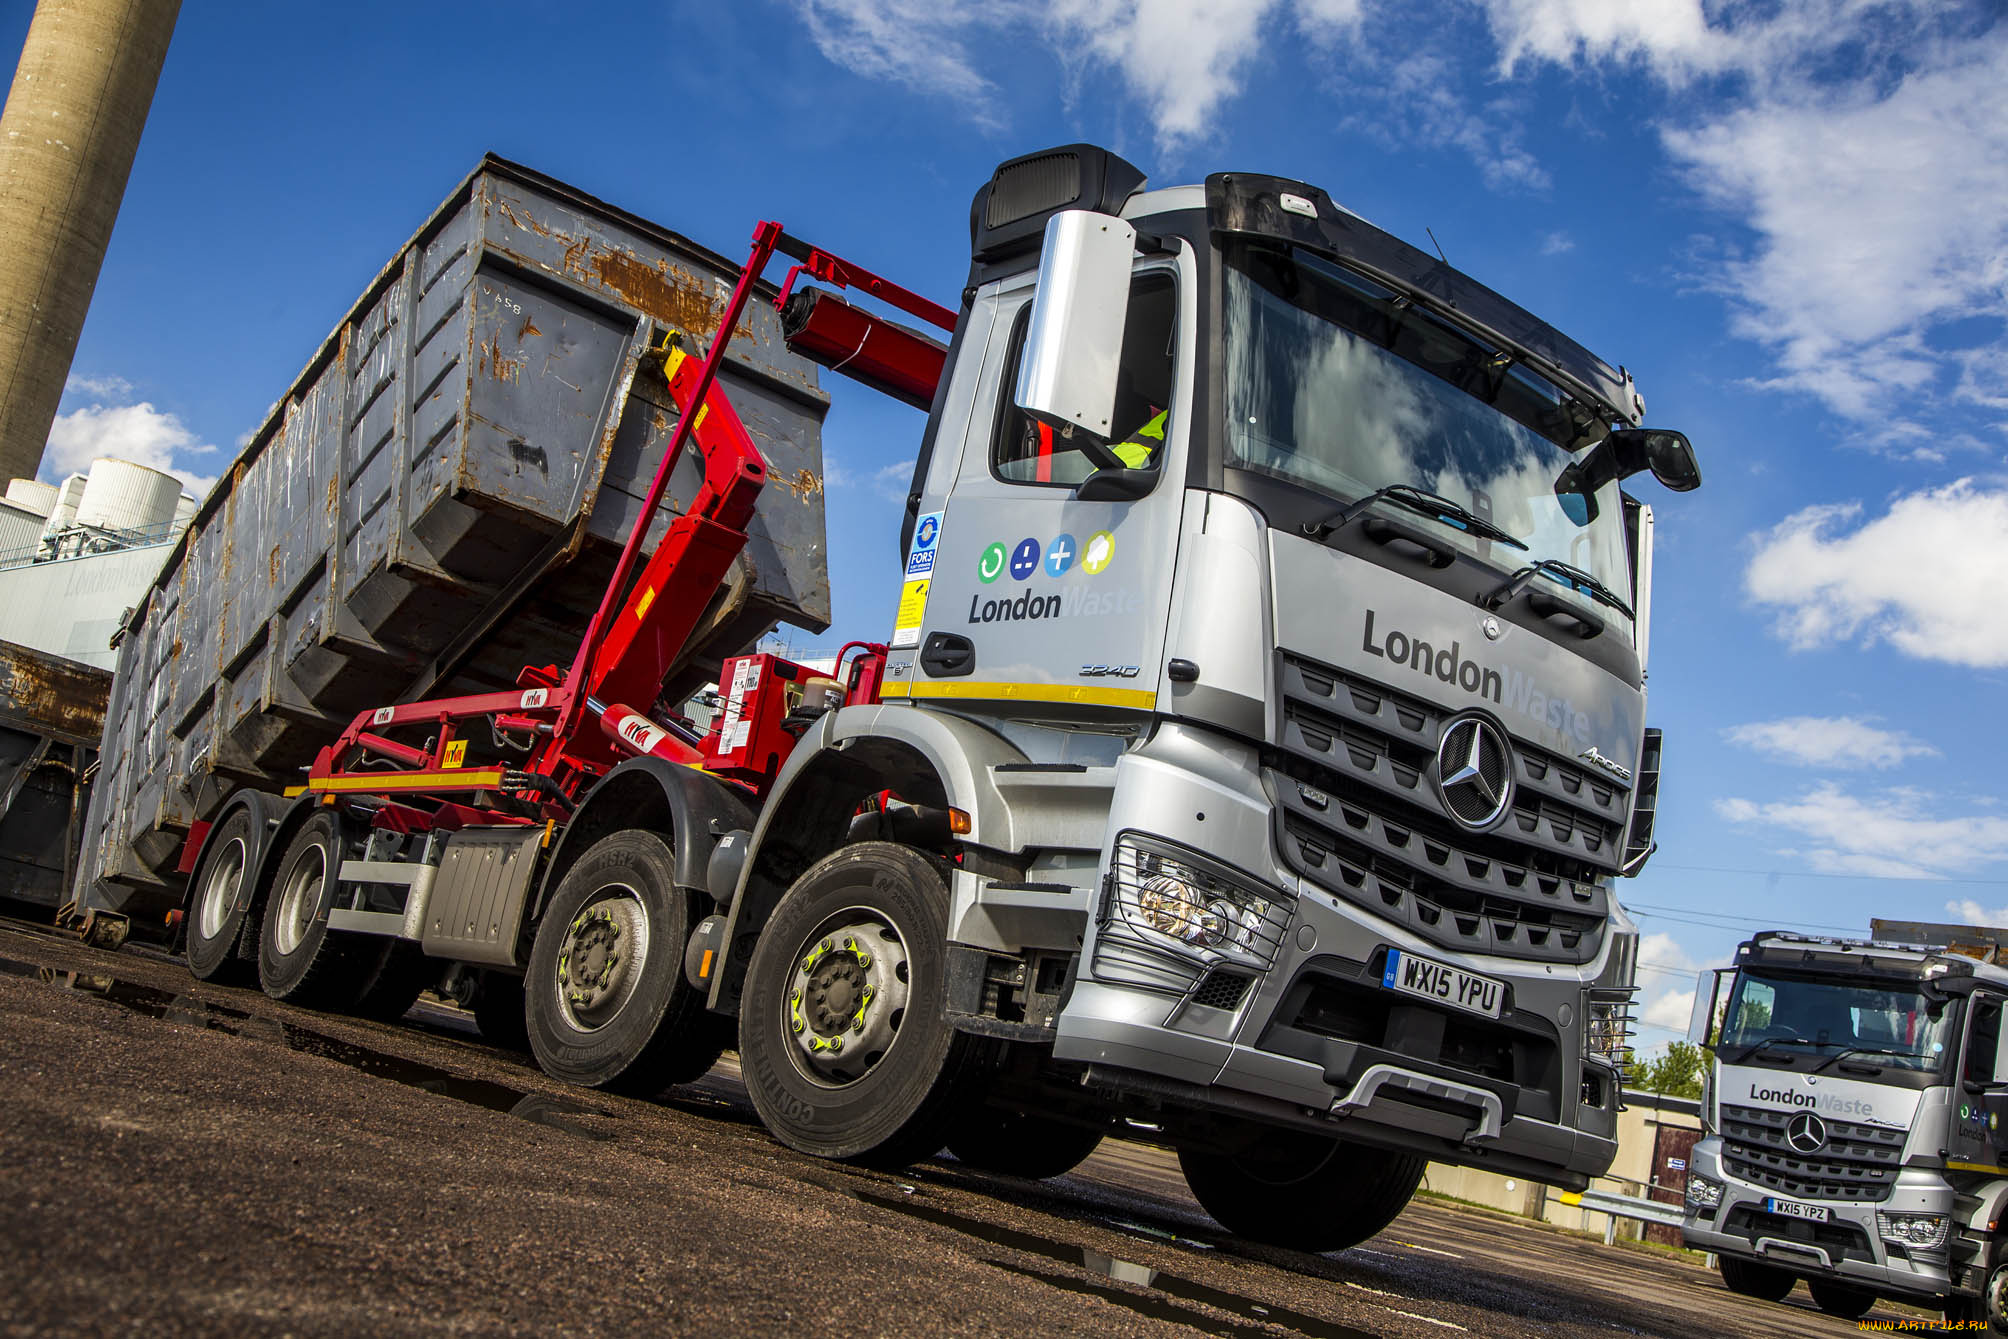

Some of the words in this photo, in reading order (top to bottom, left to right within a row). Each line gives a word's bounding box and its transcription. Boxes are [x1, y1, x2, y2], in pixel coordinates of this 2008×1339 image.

[911, 551, 933, 564] FORS
[1079, 664, 1140, 678] 3240
[1362, 609, 1590, 741] LondonWaste
[525, 690, 541, 706] HYVA
[377, 709, 391, 723] HYVA
[624, 721, 650, 746] HYVA
[445, 744, 463, 762] HYVA
[1404, 958, 1452, 998] WX15
[1458, 974, 1497, 1011] YPU
[1750, 1084, 1873, 1116] LondonWaste
[1776, 1201, 1801, 1215] WX15
[1803, 1206, 1825, 1220] YPZ
